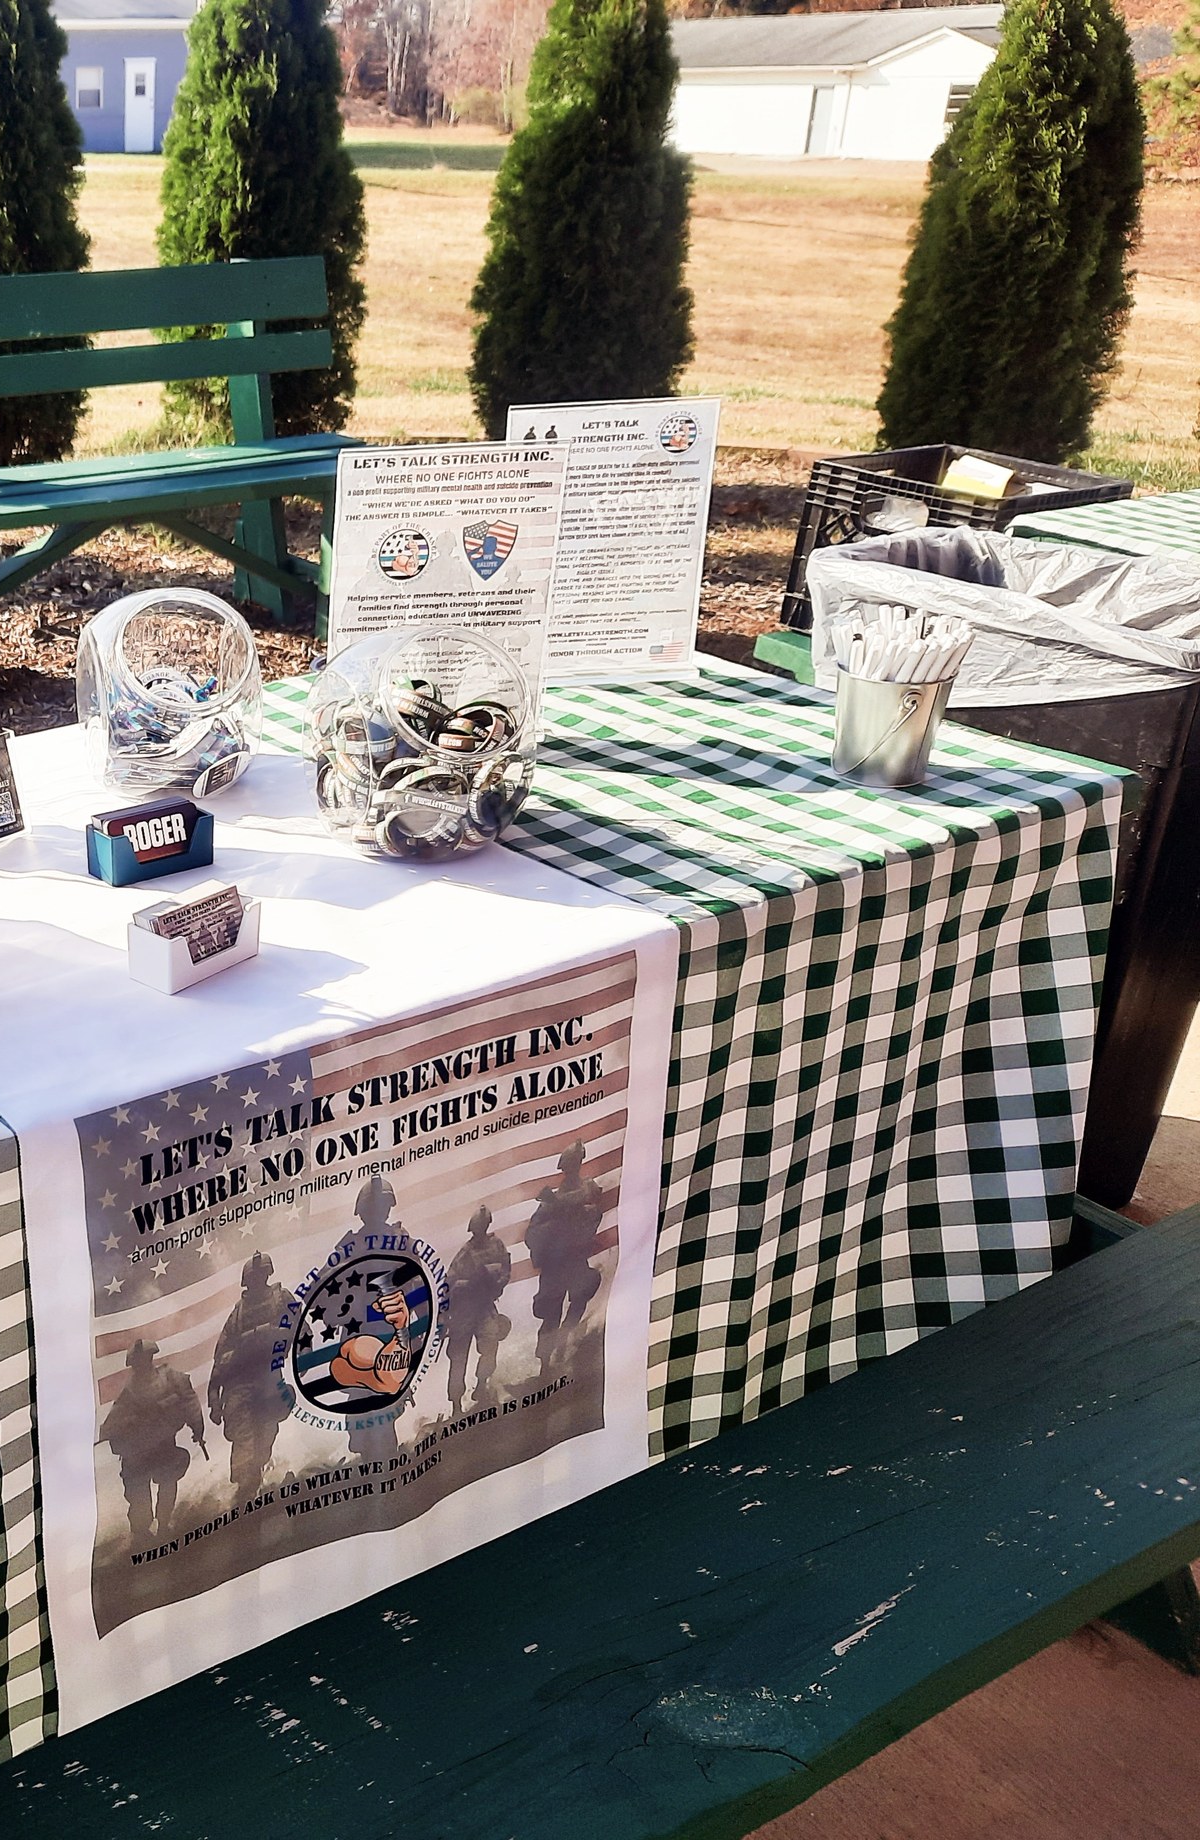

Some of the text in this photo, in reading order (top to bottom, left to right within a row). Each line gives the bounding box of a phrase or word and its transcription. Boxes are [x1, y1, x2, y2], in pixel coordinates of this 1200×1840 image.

[582, 420, 639, 430] LET'S TALK
[627, 433, 648, 441] INC.
[354, 451, 554, 469] LET'S TALK STRENGTH INC.
[376, 474, 413, 484] WHERE
[434, 472, 455, 481] ONE
[458, 470, 493, 480] FIGHTS
[496, 469, 530, 479] ALONE
[347, 595, 378, 603] Helping
[449, 600, 482, 608] through
[485, 599, 523, 607] personal
[473, 619, 505, 627] military
[548, 650, 574, 658] HONOR
[123, 812, 187, 853] ROGER
[140, 1015, 594, 1186] LET'S TALK STRENGTH INC.
[131, 1052, 604, 1235] WHERE NO ONE FIGHTS ALONE
[131, 1088, 604, 1264] a non-profit supporting military mental health and suicide prevention
[271, 1234, 450, 1373] BE PART OF THE CHANGE
[131, 1538, 180, 1566] WHEN
[184, 1506, 240, 1547] PEOPLE
[243, 1490, 275, 1516] ASK
[279, 1481, 300, 1499] US
[304, 1467, 353, 1491] WHAT
[358, 1461, 383, 1477] WE
[388, 1453, 411, 1471] DO,
[413, 1432, 437, 1458] THE
[440, 1406, 498, 1441] ANSWER
[501, 1400, 518, 1416] IS
[285, 1450, 443, 1519] WHATEVER IT TAKES!
